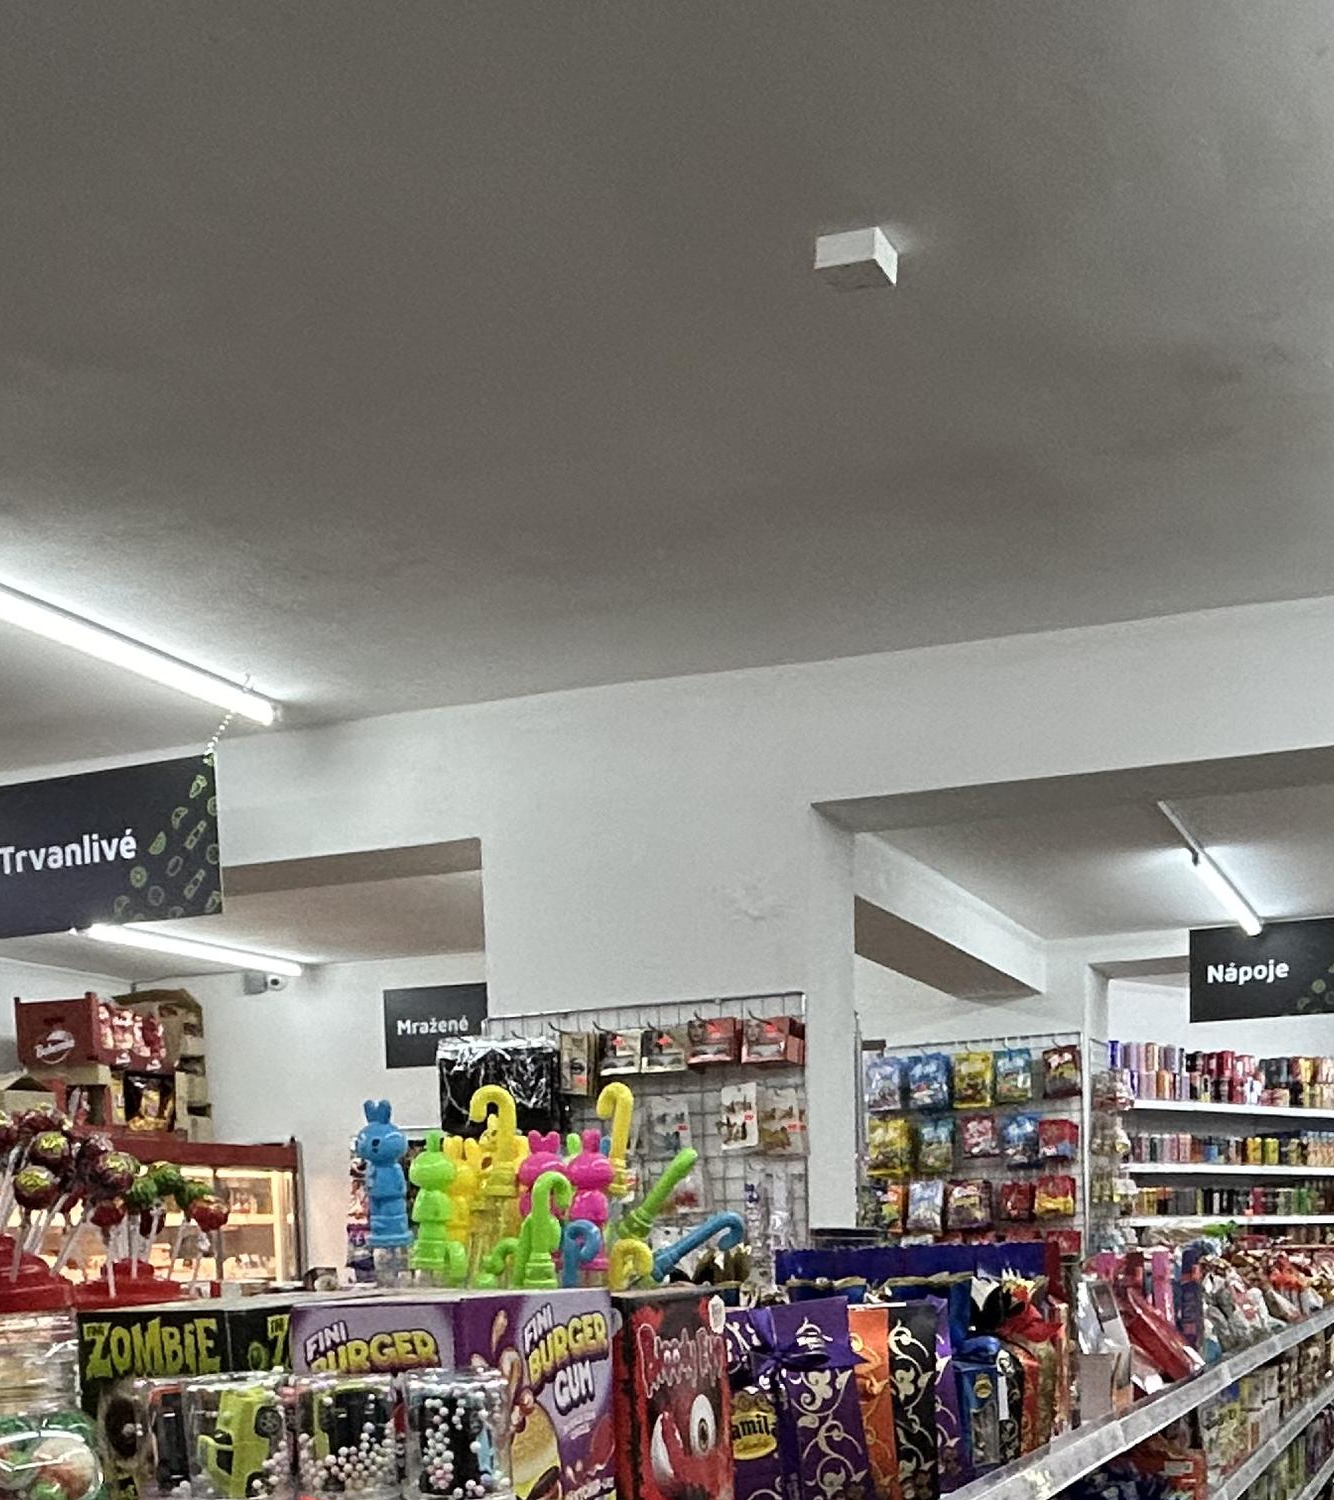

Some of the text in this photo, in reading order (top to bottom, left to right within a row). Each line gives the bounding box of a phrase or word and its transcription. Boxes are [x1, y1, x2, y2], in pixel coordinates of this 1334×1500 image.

[1206, 959, 1290, 986] Nápoje
[397, 1017, 469, 1036] Mražené
[304, 1320, 347, 1362] FINI
[524, 1303, 554, 1354] FINI
[528, 1311, 608, 1386] BURGER
[554, 1361, 595, 1413] GUM
